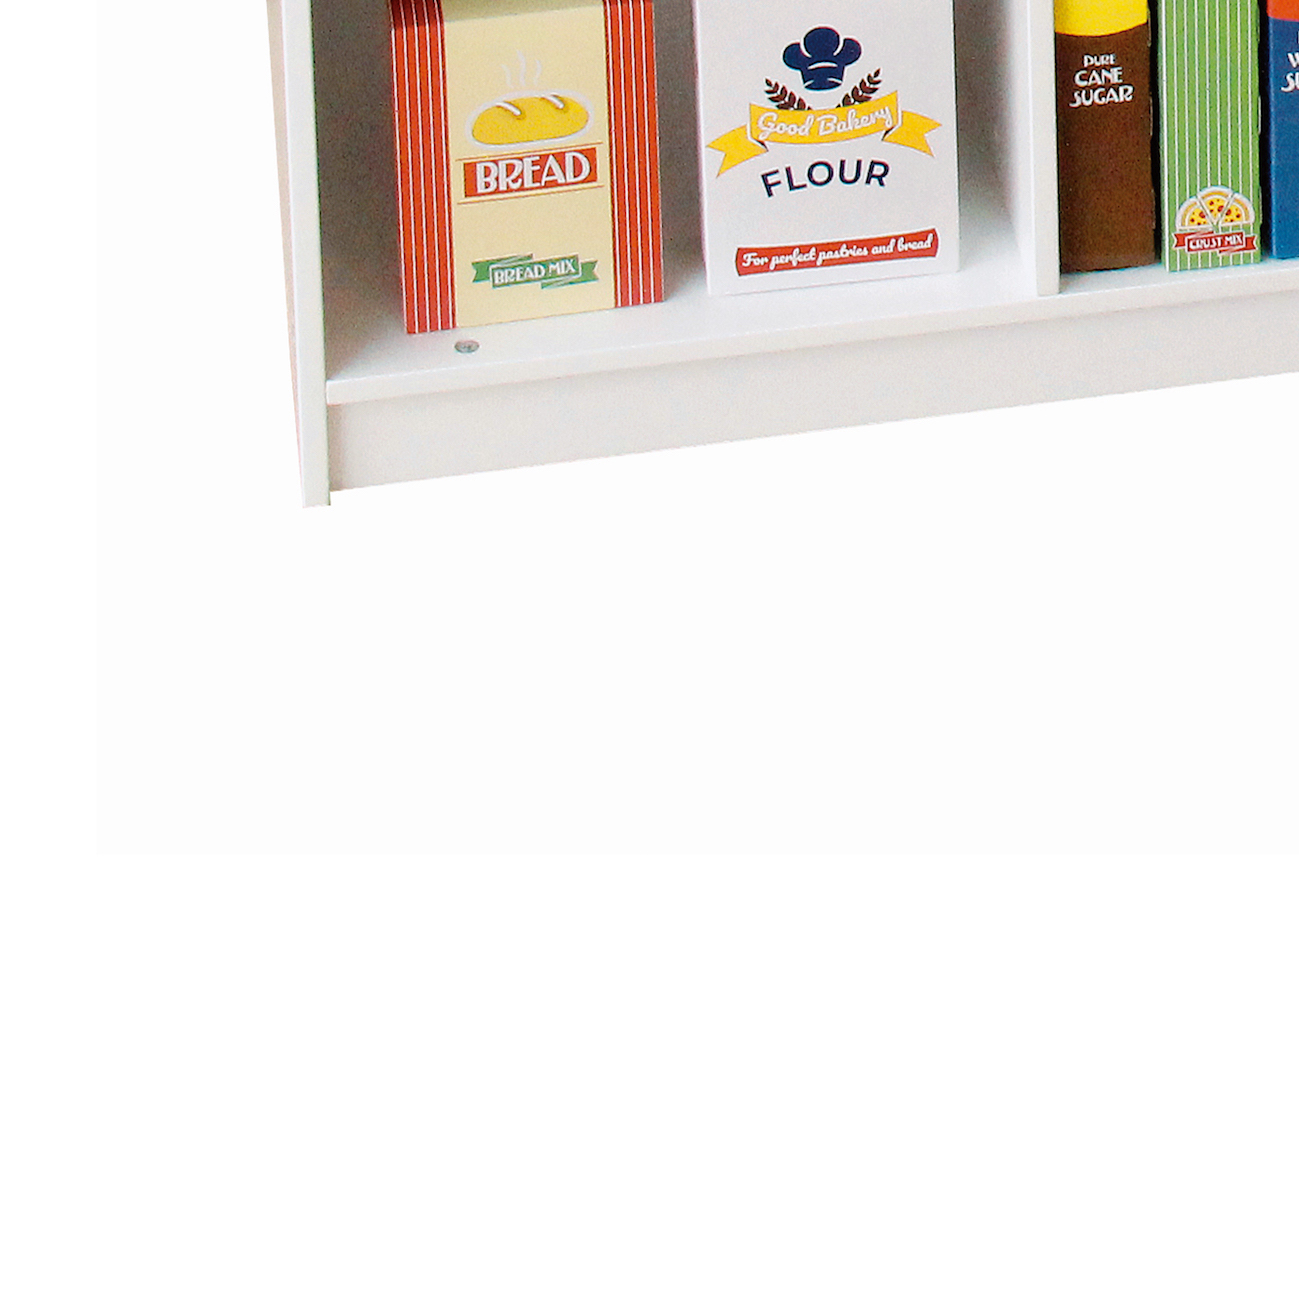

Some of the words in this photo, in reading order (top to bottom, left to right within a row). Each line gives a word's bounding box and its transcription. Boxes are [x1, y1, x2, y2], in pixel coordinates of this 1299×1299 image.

[1083, 53, 1116, 68] PURE
[1074, 67, 1123, 87] CANE
[1068, 85, 1134, 107] SUGAR
[758, 111, 815, 140] Good
[816, 105, 893, 137] Bakery
[476, 151, 592, 193] BREAD
[760, 159, 890, 198] FLOUR
[742, 252, 768, 267] For
[769, 247, 816, 271] perfect
[816, 243, 868, 265] pastries
[872, 238, 896, 254] and
[897, 233, 934, 251] bread
[1189, 237, 1222, 249] CRUST
[1224, 234, 1242, 245] MIX
[494, 264, 546, 284] BREAD
[548, 259, 576, 276] MIX
